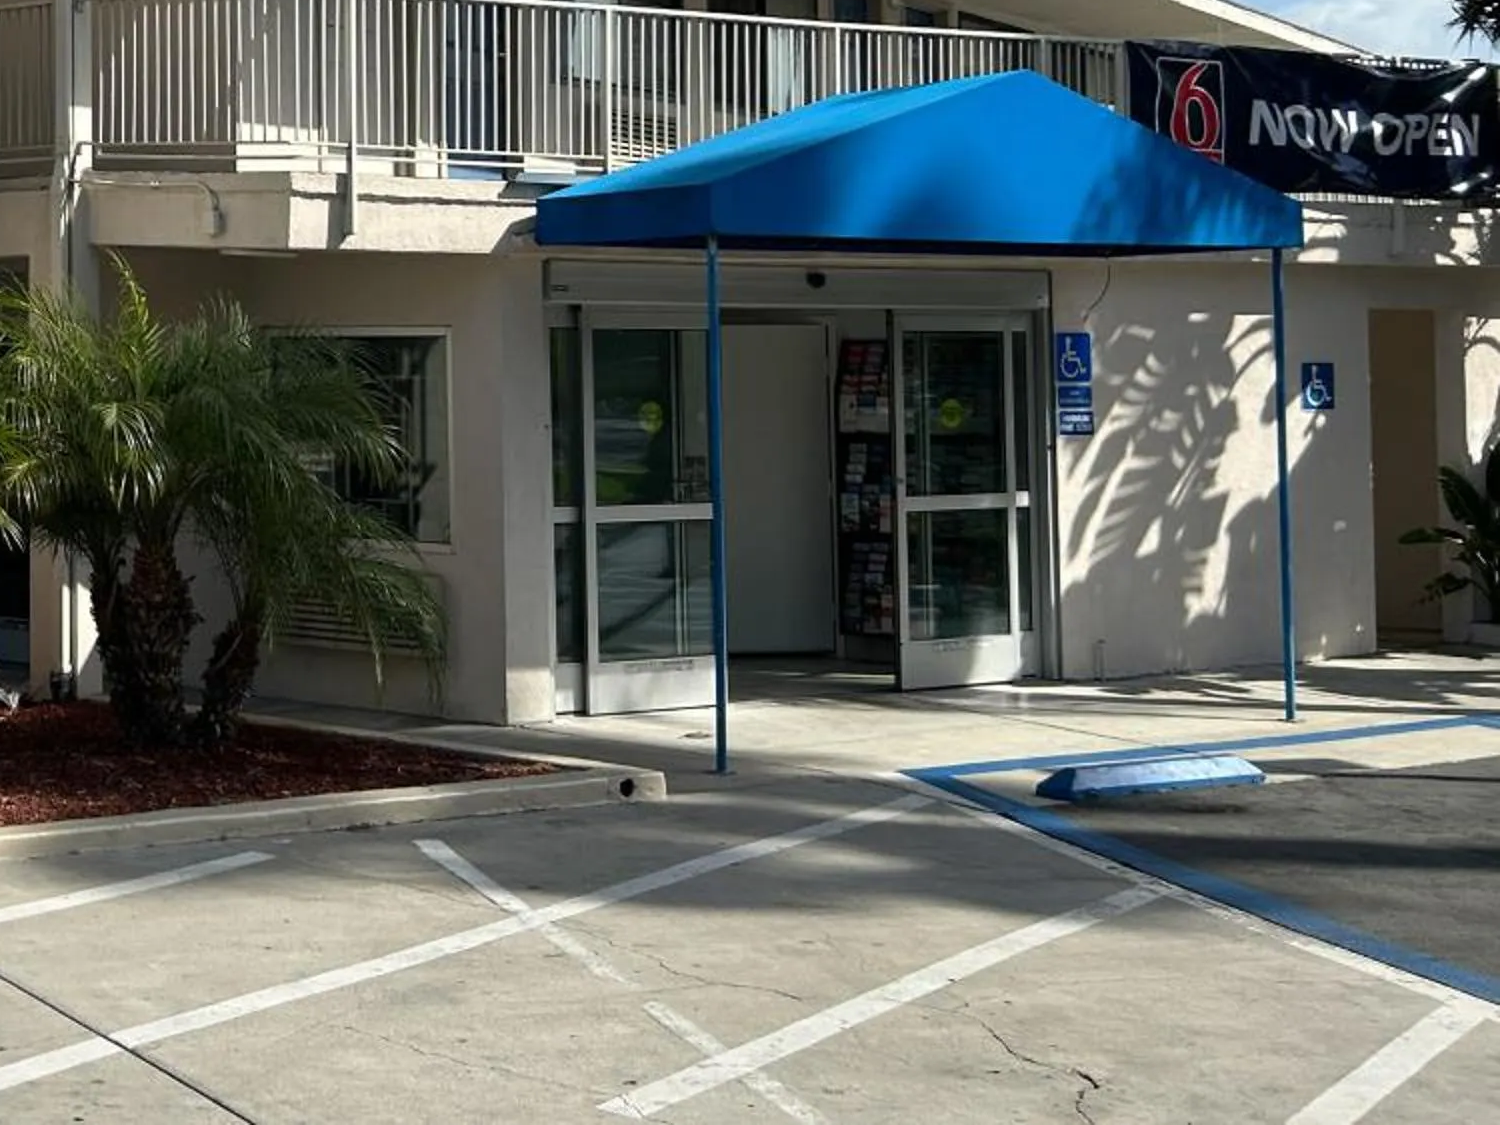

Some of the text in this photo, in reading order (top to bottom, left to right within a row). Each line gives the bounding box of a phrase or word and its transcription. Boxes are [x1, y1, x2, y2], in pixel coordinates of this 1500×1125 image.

[1169, 60, 1220, 150] 6
[1248, 99, 1480, 157] NOW OPEN
